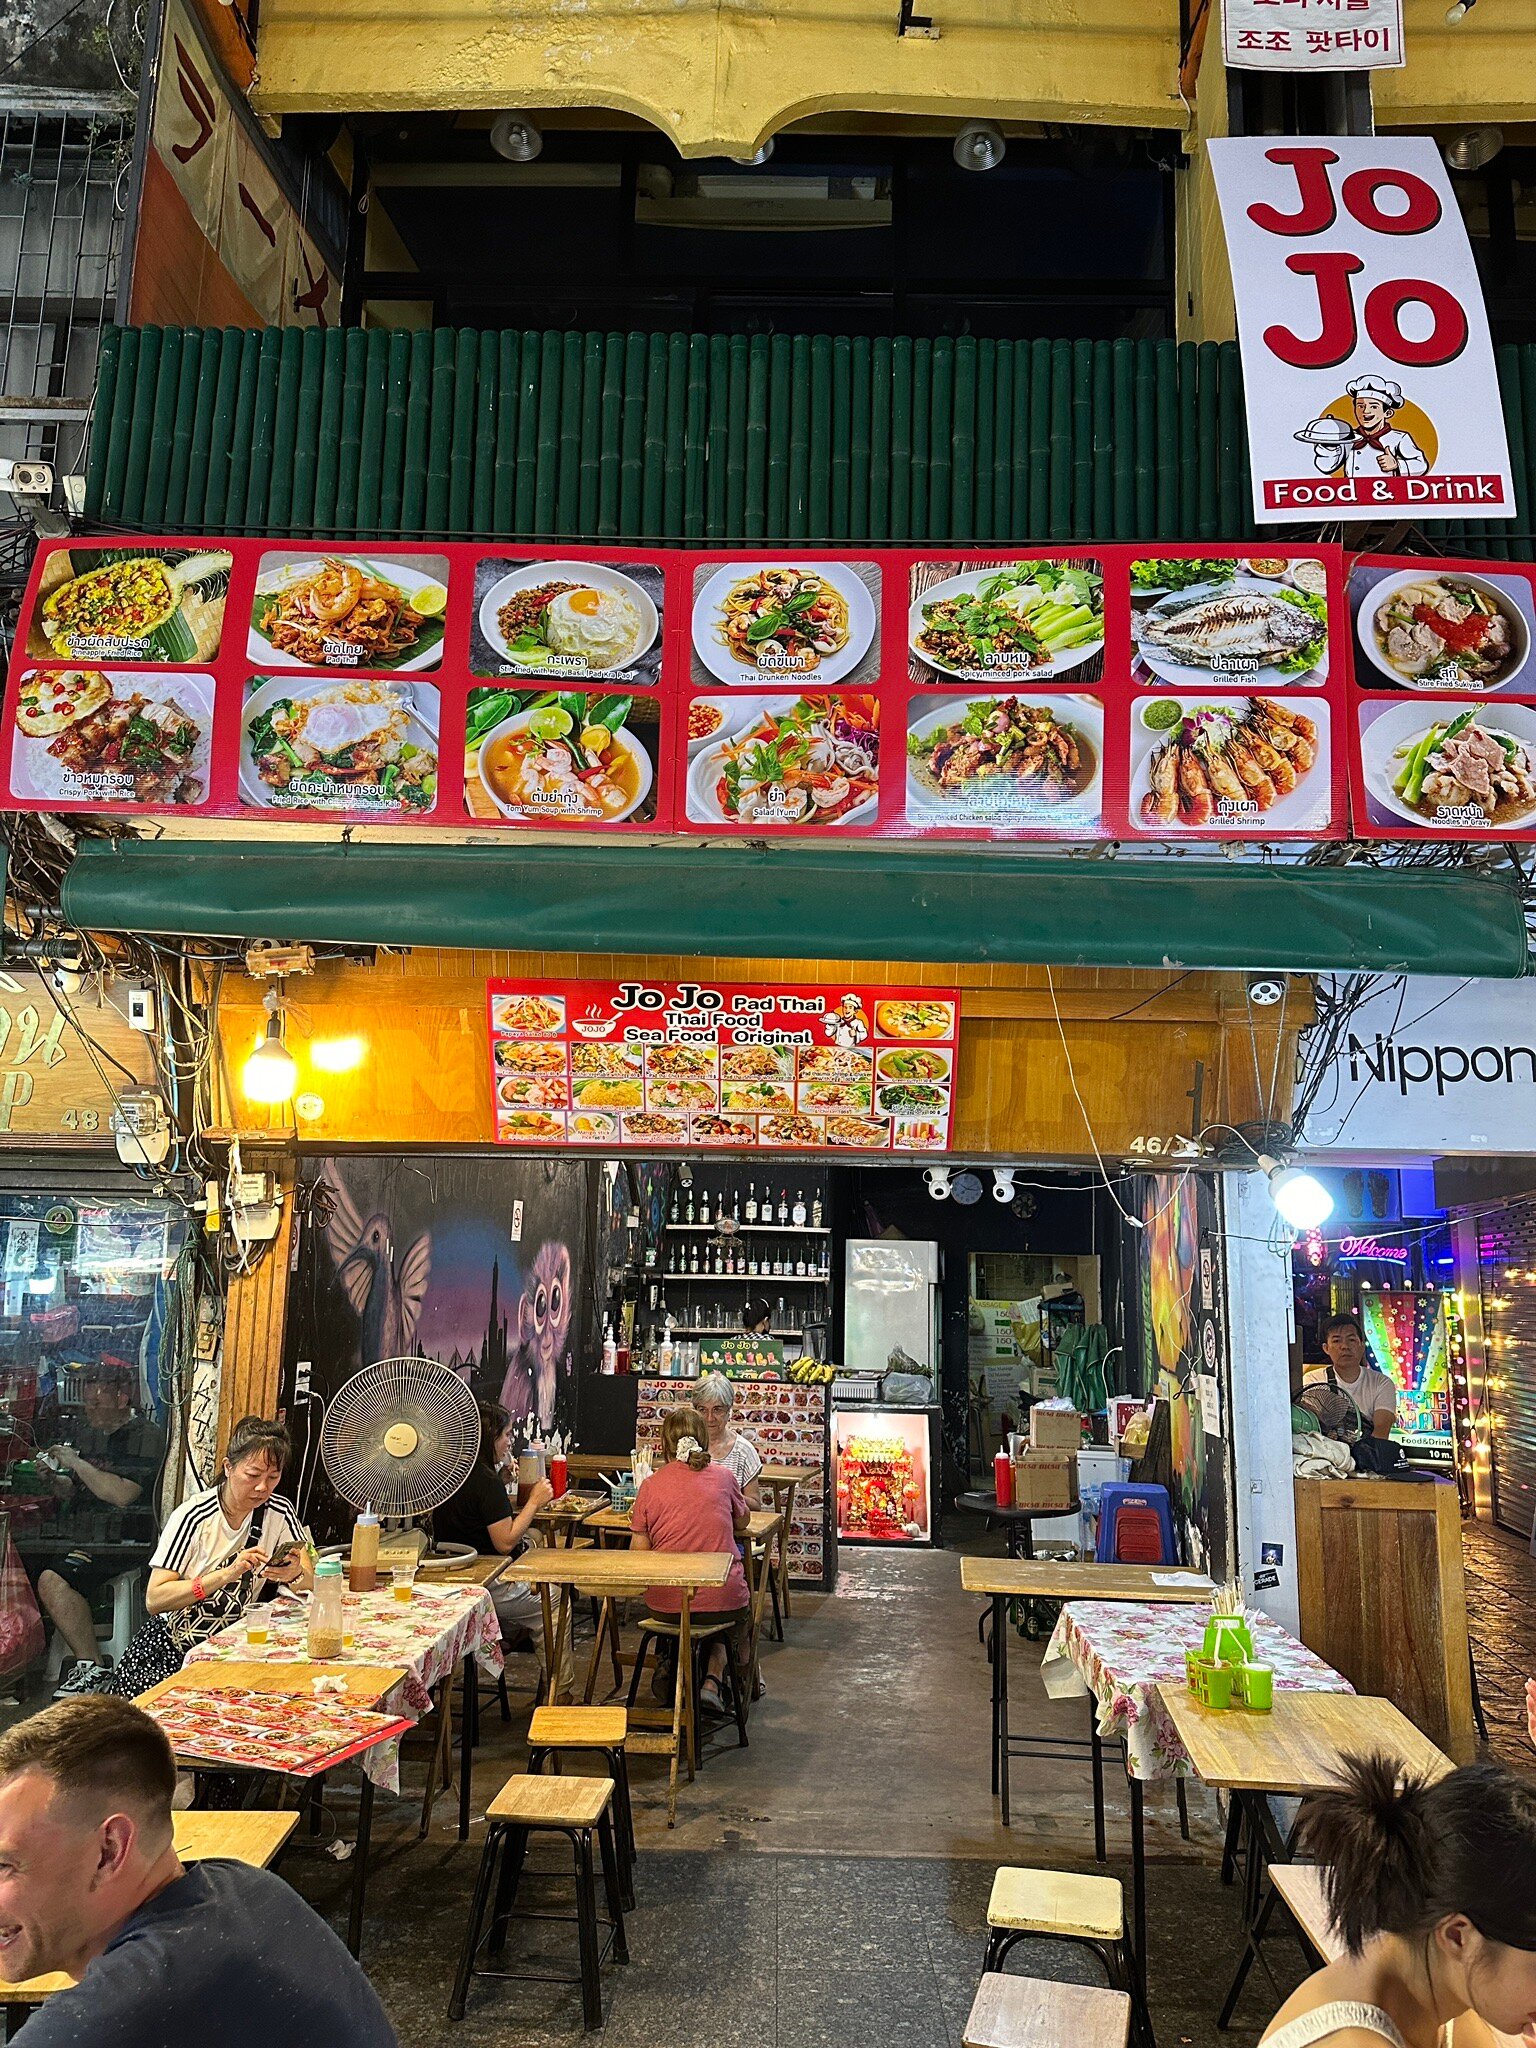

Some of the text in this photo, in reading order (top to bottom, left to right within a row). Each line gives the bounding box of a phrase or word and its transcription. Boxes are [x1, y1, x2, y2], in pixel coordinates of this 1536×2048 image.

[1237, 28, 1389, 53] 조조 팟타이
[1246, 147, 1442, 237] Jo
[1262, 252, 1469, 370] Jo
[1273, 476, 1497, 505] Food & Drink
[71, 649, 106, 657] Pineapple
[107, 649, 125, 657] Fried
[323, 641, 363, 655] ผัดไทย
[326, 656, 358, 664] Pad Thai
[547, 654, 588, 667] กะเพรา
[758, 648, 805, 667] ผัดขี้เมา
[984, 652, 1028, 668] ลาบหมู
[1211, 654, 1258, 671] ปลาเผา
[499, 665, 531, 674] Stir-fried
[532, 667, 548, 675] with
[550, 668, 566, 677] Holy
[567, 669, 584, 677] Basil
[603, 671, 616, 679] Kra
[791, 673, 822, 681] Noodles
[960, 669, 1053, 679] Spicy minced pork salad
[1213, 675, 1256, 683] Grilled Fish
[1436, 680, 1453, 688] Fried
[1455, 681, 1483, 690] Sukiyaki
[63, 768, 134, 788] ข้าวหมูกรอบ
[59, 789, 81, 797] Crispy
[84, 789, 99, 797] Pork
[102, 789, 116, 797] with
[532, 787, 578, 807] ต้มยำกุ้ง
[769, 787, 785, 802] ยำ
[273, 796, 291, 804] Fried
[294, 797, 309, 805] Rice
[386, 800, 401, 809] Kale
[1218, 797, 1258, 816] กุ้งเผา
[541, 806, 559, 815] Soup
[577, 807, 602, 817] Shrimp
[754, 808, 774, 816] Salad
[1437, 804, 1483, 818] ราดหน้า
[1210, 817, 1265, 827] Grilled Shrimp
[1432, 818, 1491, 827] Noodles in Gravy
[613, 985, 822, 1011] Jo Jo Pad Thai
[665, 1012, 760, 1026] Thai Food
[626, 1029, 811, 1045] Sea Food Original
[1348, 1033, 1536, 1096] Nippon
[61, 1109, 99, 1131] 48
[1340, 1236, 1407, 1259] Welcome
[721, 1341, 751, 1350] Jo Jo
[654, 1381, 667, 1389] JO
[765, 1384, 778, 1392] JO
[1401, 1437, 1452, 1447] Food&Drink
[1429, 1450, 1440, 1458] 10
